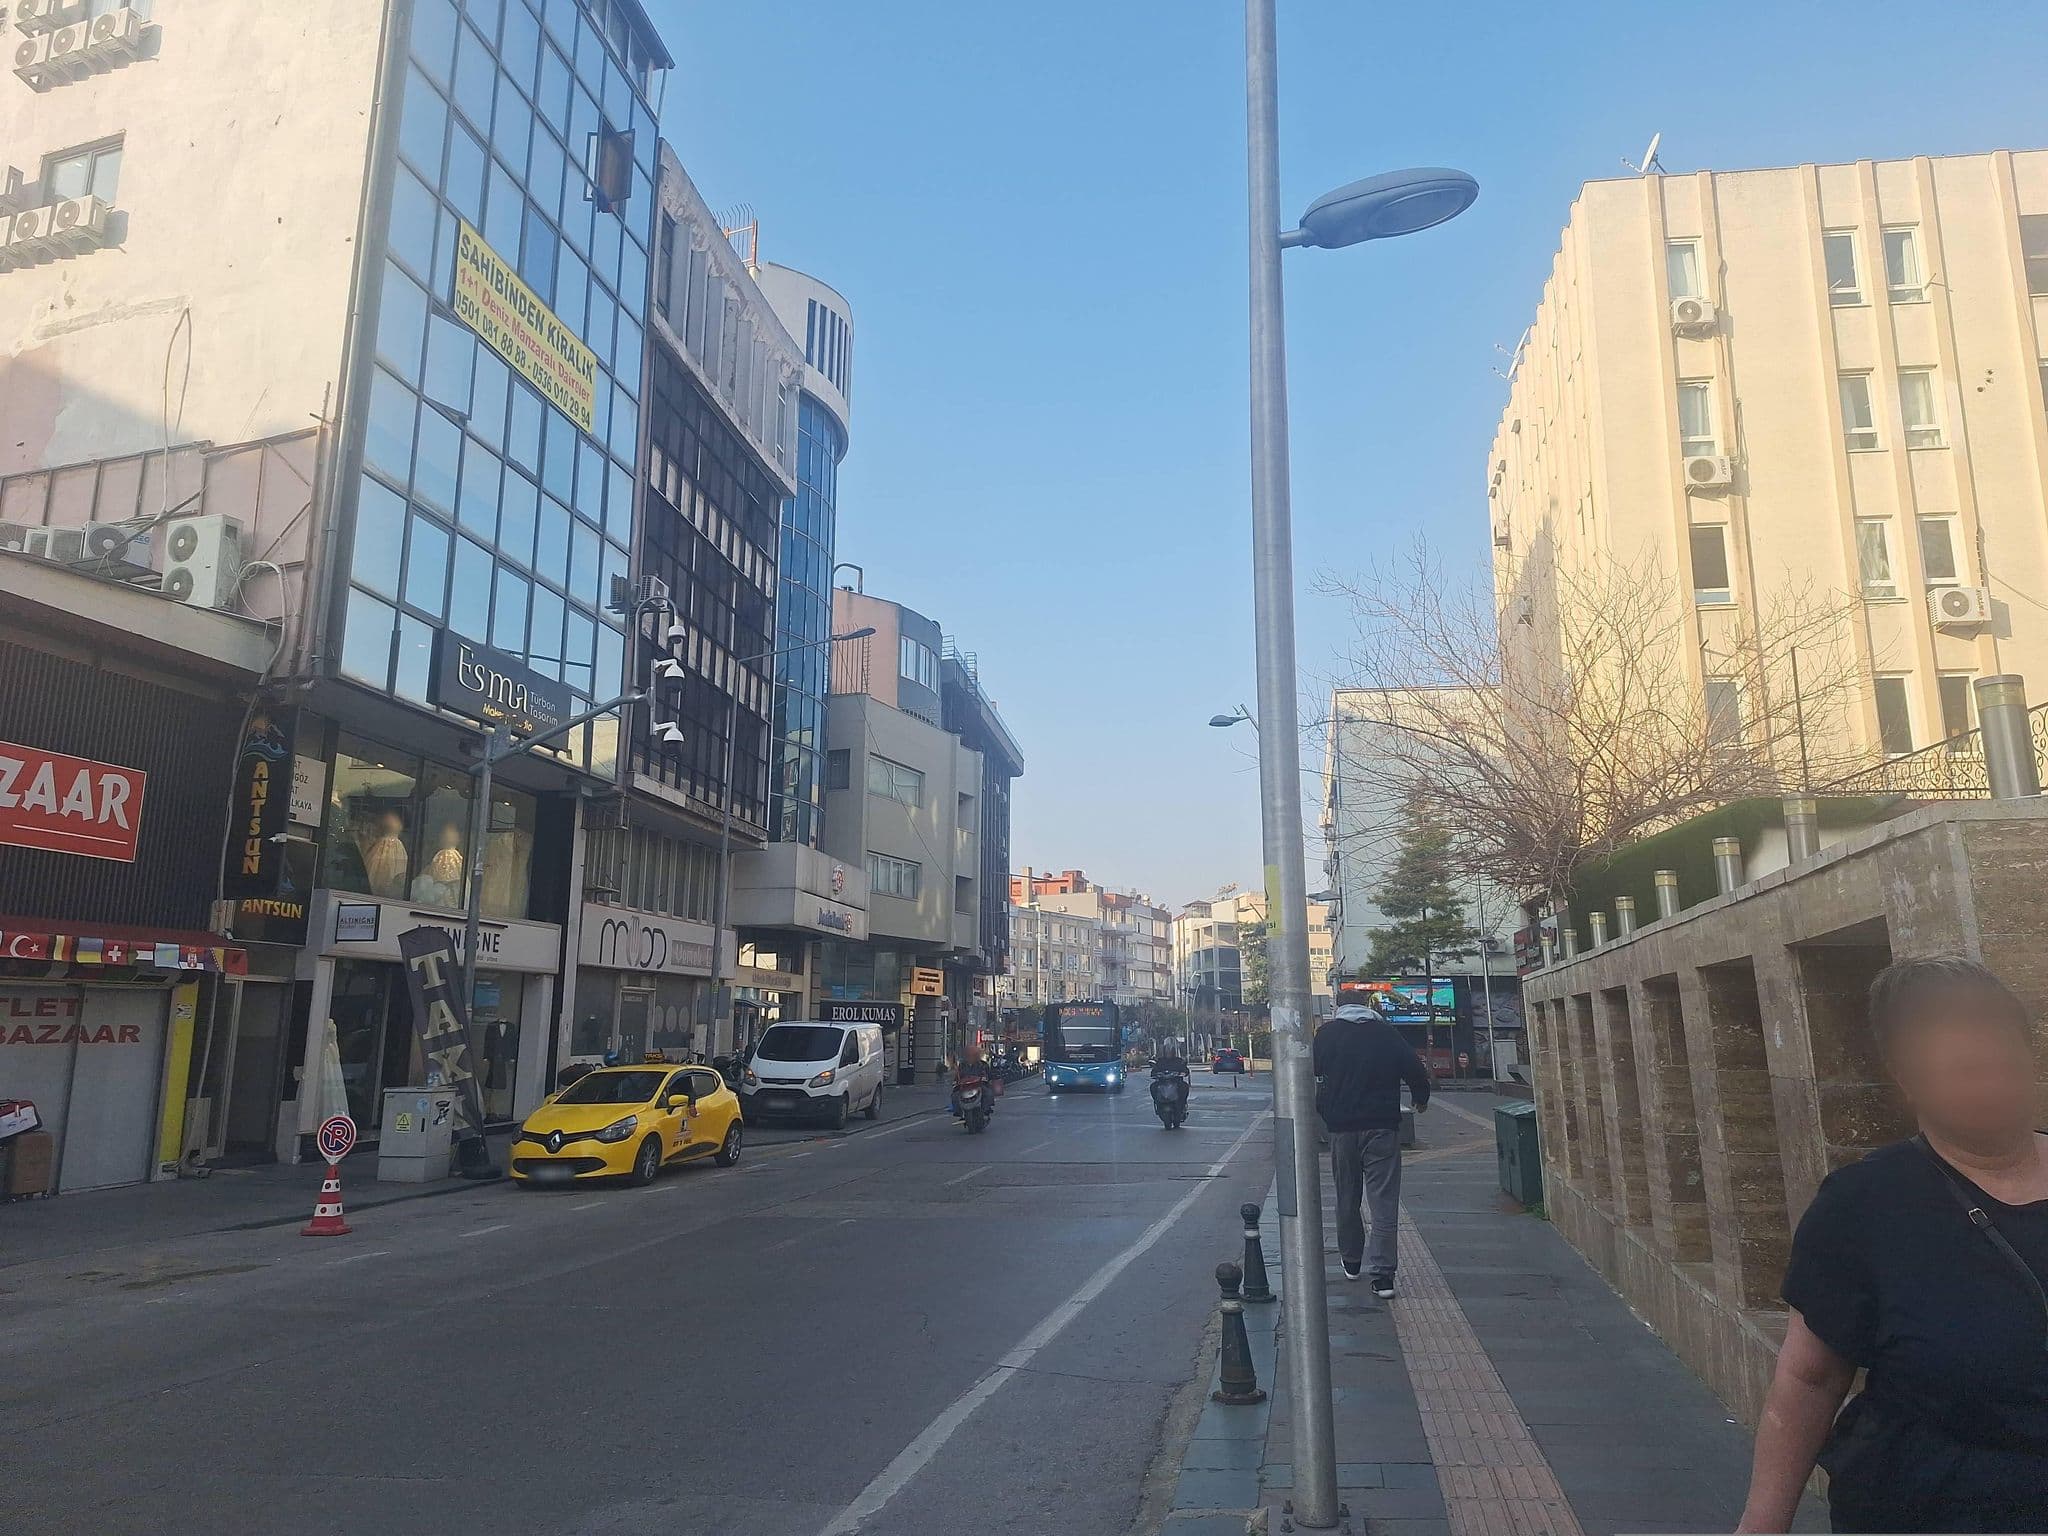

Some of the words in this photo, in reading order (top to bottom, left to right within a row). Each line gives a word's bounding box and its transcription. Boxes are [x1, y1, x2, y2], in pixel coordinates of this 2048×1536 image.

[460, 233, 545, 336] SAHİBİNDEN
[455, 289, 480, 325] 0501
[482, 314, 499, 344] 081
[500, 332, 513, 356] 88
[514, 345, 526, 368] 88
[532, 361, 552, 393] 0536
[554, 382, 569, 408] 010
[569, 396, 579, 417] 29
[581, 406, 590, 428] 94
[481, 287, 510, 328] Deniz
[511, 317, 556, 371] Manzaralı
[558, 361, 590, 402] Daireler
[458, 642, 528, 713] Esma
[530, 691, 556, 712] Turban
[242, 761, 269, 875] ANTSUN
[241, 899, 303, 920] ANTSUN
[831, 1006, 860, 1021] EROL
[860, 1007, 896, 1024] KUMAŞ
